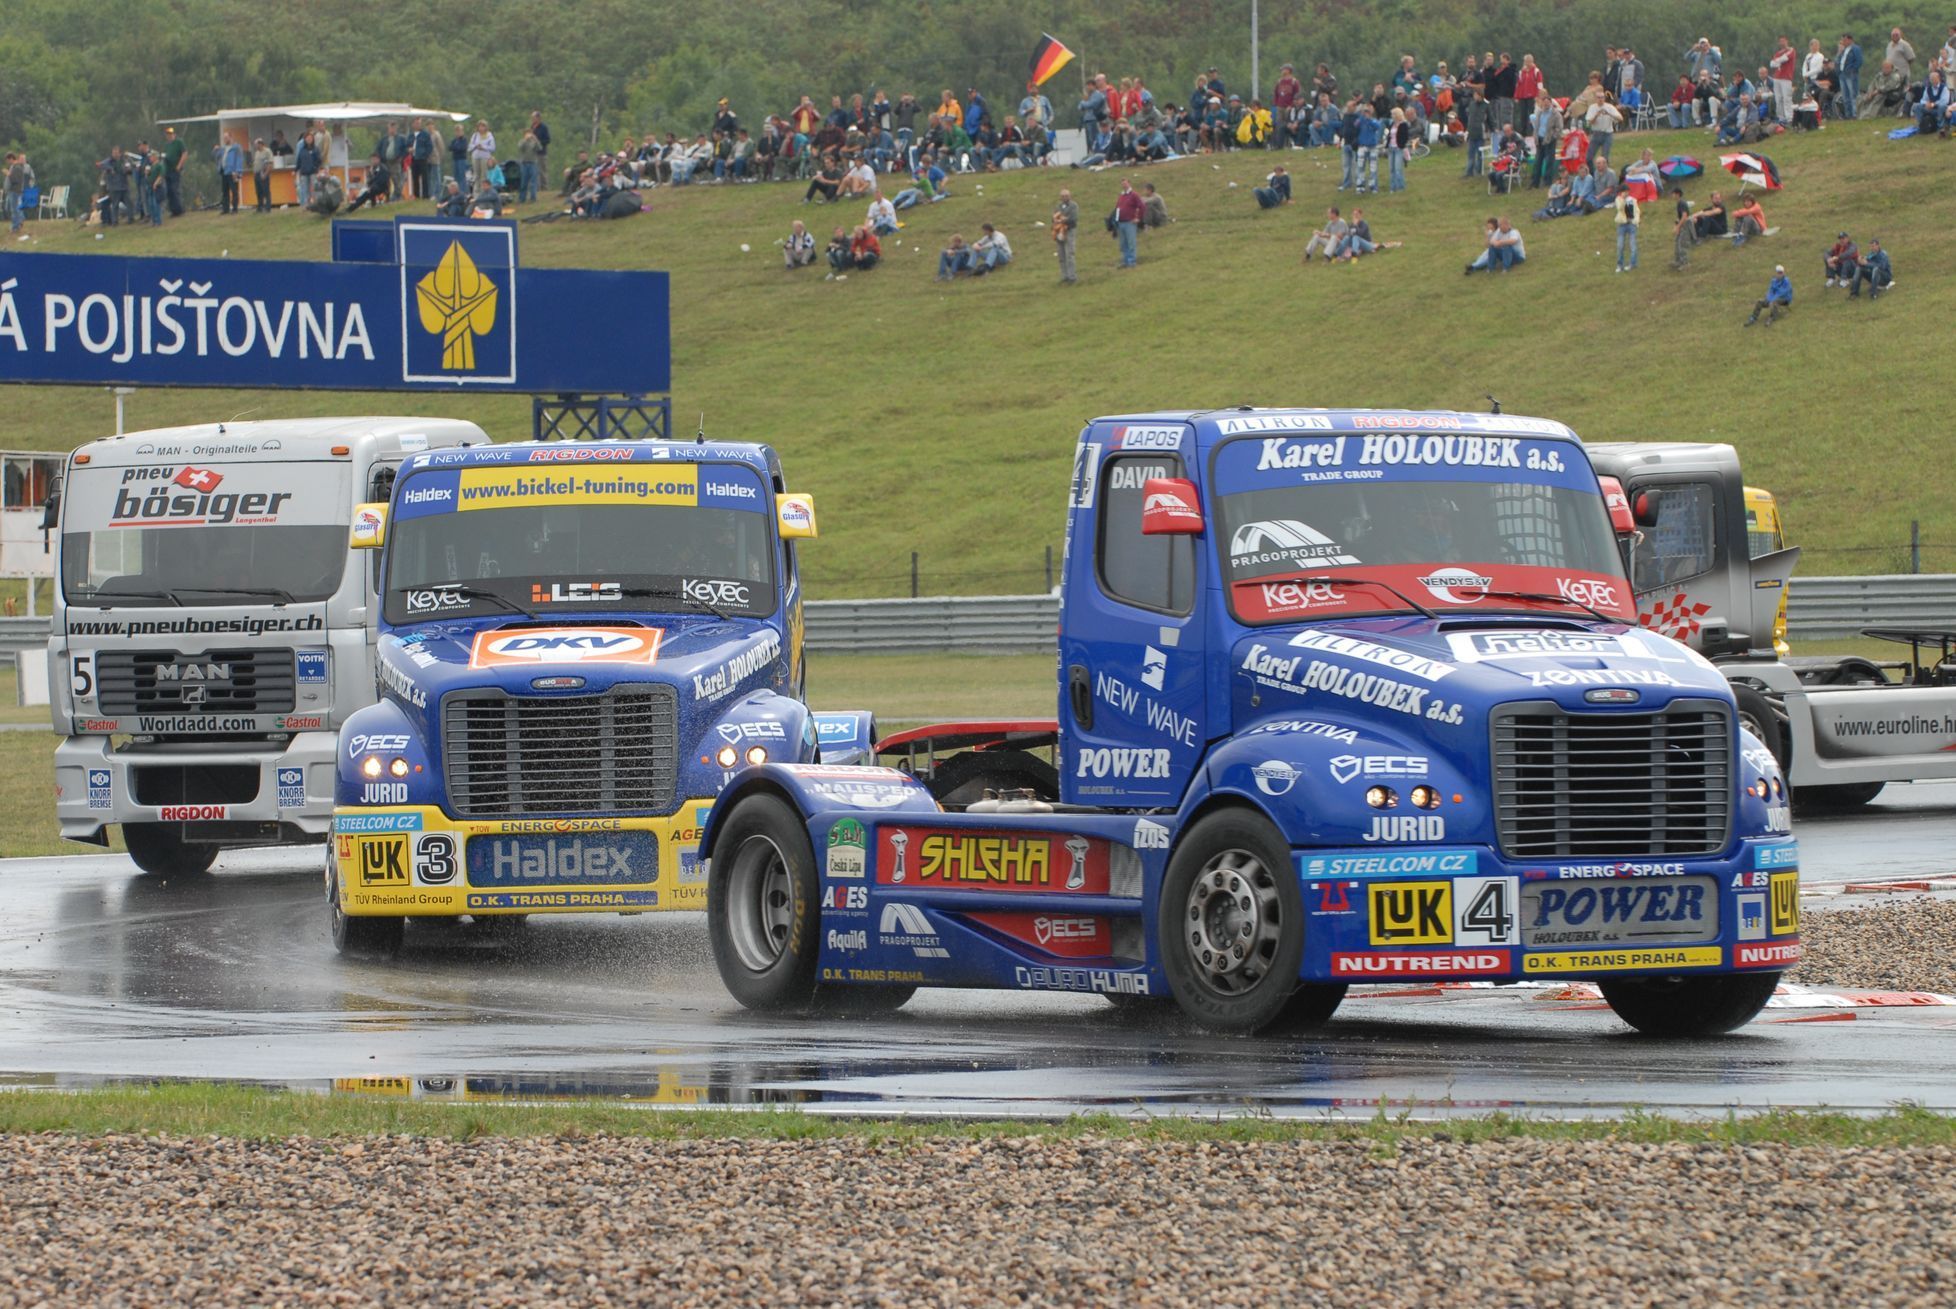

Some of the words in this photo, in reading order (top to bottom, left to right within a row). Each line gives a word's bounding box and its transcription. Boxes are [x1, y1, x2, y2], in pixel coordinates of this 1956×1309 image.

[44, 278, 375, 363] POJIŠŤOVNA
[1354, 415, 1461, 429] RIGDON
[1126, 431, 1179, 447] LAPOS
[157, 447, 182, 456] MAN
[193, 443, 258, 457] Originalteile
[435, 454, 467, 464] NEW
[475, 451, 513, 461] WAVE
[529, 448, 635, 462] RIGDON
[675, 449, 708, 457] NEW
[716, 449, 753, 461] WAVE
[1256, 436, 1347, 471] Karel
[1359, 435, 1521, 468] HOLOUBEK
[1527, 448, 1565, 472] a.s.
[121, 467, 174, 485] pneu
[1111, 466, 1167, 489] DAVID
[1302, 471, 1343, 481] TRADE
[1344, 470, 1384, 479] GROUP
[404, 488, 452, 504] Haldex
[462, 476, 695, 500] www.bickel-tuning.com
[706, 482, 756, 498] Haldex
[112, 486, 292, 524] bösiger
[1231, 545, 1342, 568] PRAGOPROJEKT
[69, 614, 323, 638] www.pneuboesiger.ch
[499, 636, 632, 652] DKV
[299, 655, 325, 663] VOITH
[73, 657, 93, 696] 5
[156, 663, 230, 680] MAN
[693, 665, 727, 700] Karel
[729, 639, 772, 685] HOLOUBEK
[1241, 644, 1303, 682] Karel
[1302, 661, 1430, 716] HOLOUBEK
[1426, 699, 1464, 725] a.s.
[1256, 676, 1281, 689] TRADE
[1281, 682, 1307, 696] GROUP
[1096, 671, 1139, 715] NEW
[1147, 698, 1198, 748] WAVE
[87, 719, 118, 731] Castrol
[140, 716, 256, 731] Worldadd.com
[287, 717, 321, 728] Castrol
[740, 722, 785, 737] ECS
[366, 735, 411, 749] ECS
[1077, 748, 1171, 778] POWER
[1364, 756, 1428, 774] ECS
[89, 789, 112, 799] KNORR
[279, 787, 304, 798] KNORR
[360, 783, 408, 803] JURID
[89, 799, 112, 808] BREMSE
[279, 797, 305, 807] BREMSE
[161, 806, 226, 821] RIGDON
[340, 816, 395, 830] STEELCOM
[397, 816, 418, 829] CZ
[1362, 816, 1445, 841] JURID
[670, 827, 704, 842] AGE
[416, 833, 458, 885] 3
[493, 839, 633, 879] Haldex
[920, 835, 1051, 883] SHLEHA
[1329, 855, 1435, 874] STEELCOM
[1439, 855, 1468, 871] CZ
[1731, 871, 1769, 887] AGES
[372, 894, 416, 905] Rheinland
[419, 894, 453, 905] Group
[672, 885, 697, 898] TÜV
[821, 885, 868, 909] AGES
[470, 896, 504, 906] O.K.
[510, 895, 566, 905] TRANS
[570, 894, 625, 904] PRAHA
[1533, 885, 1704, 927] POWER
[1375, 888, 1448, 938] LUK
[1462, 880, 1513, 943] 4
[1053, 919, 1096, 937] ECS
[879, 935, 941, 946] PRAGOPROJEKT
[1532, 930, 1601, 944] HOLOUBEK
[1340, 955, 1501, 971] NUTREND
[1528, 958, 1562, 968] O.K.
[1569, 954, 1627, 967] TRANS
[1631, 952, 1687, 965] PRAHA
[823, 968, 846, 980] O.K.
[849, 969, 886, 981] TRANS
[888, 970, 924, 982] PRAHA
